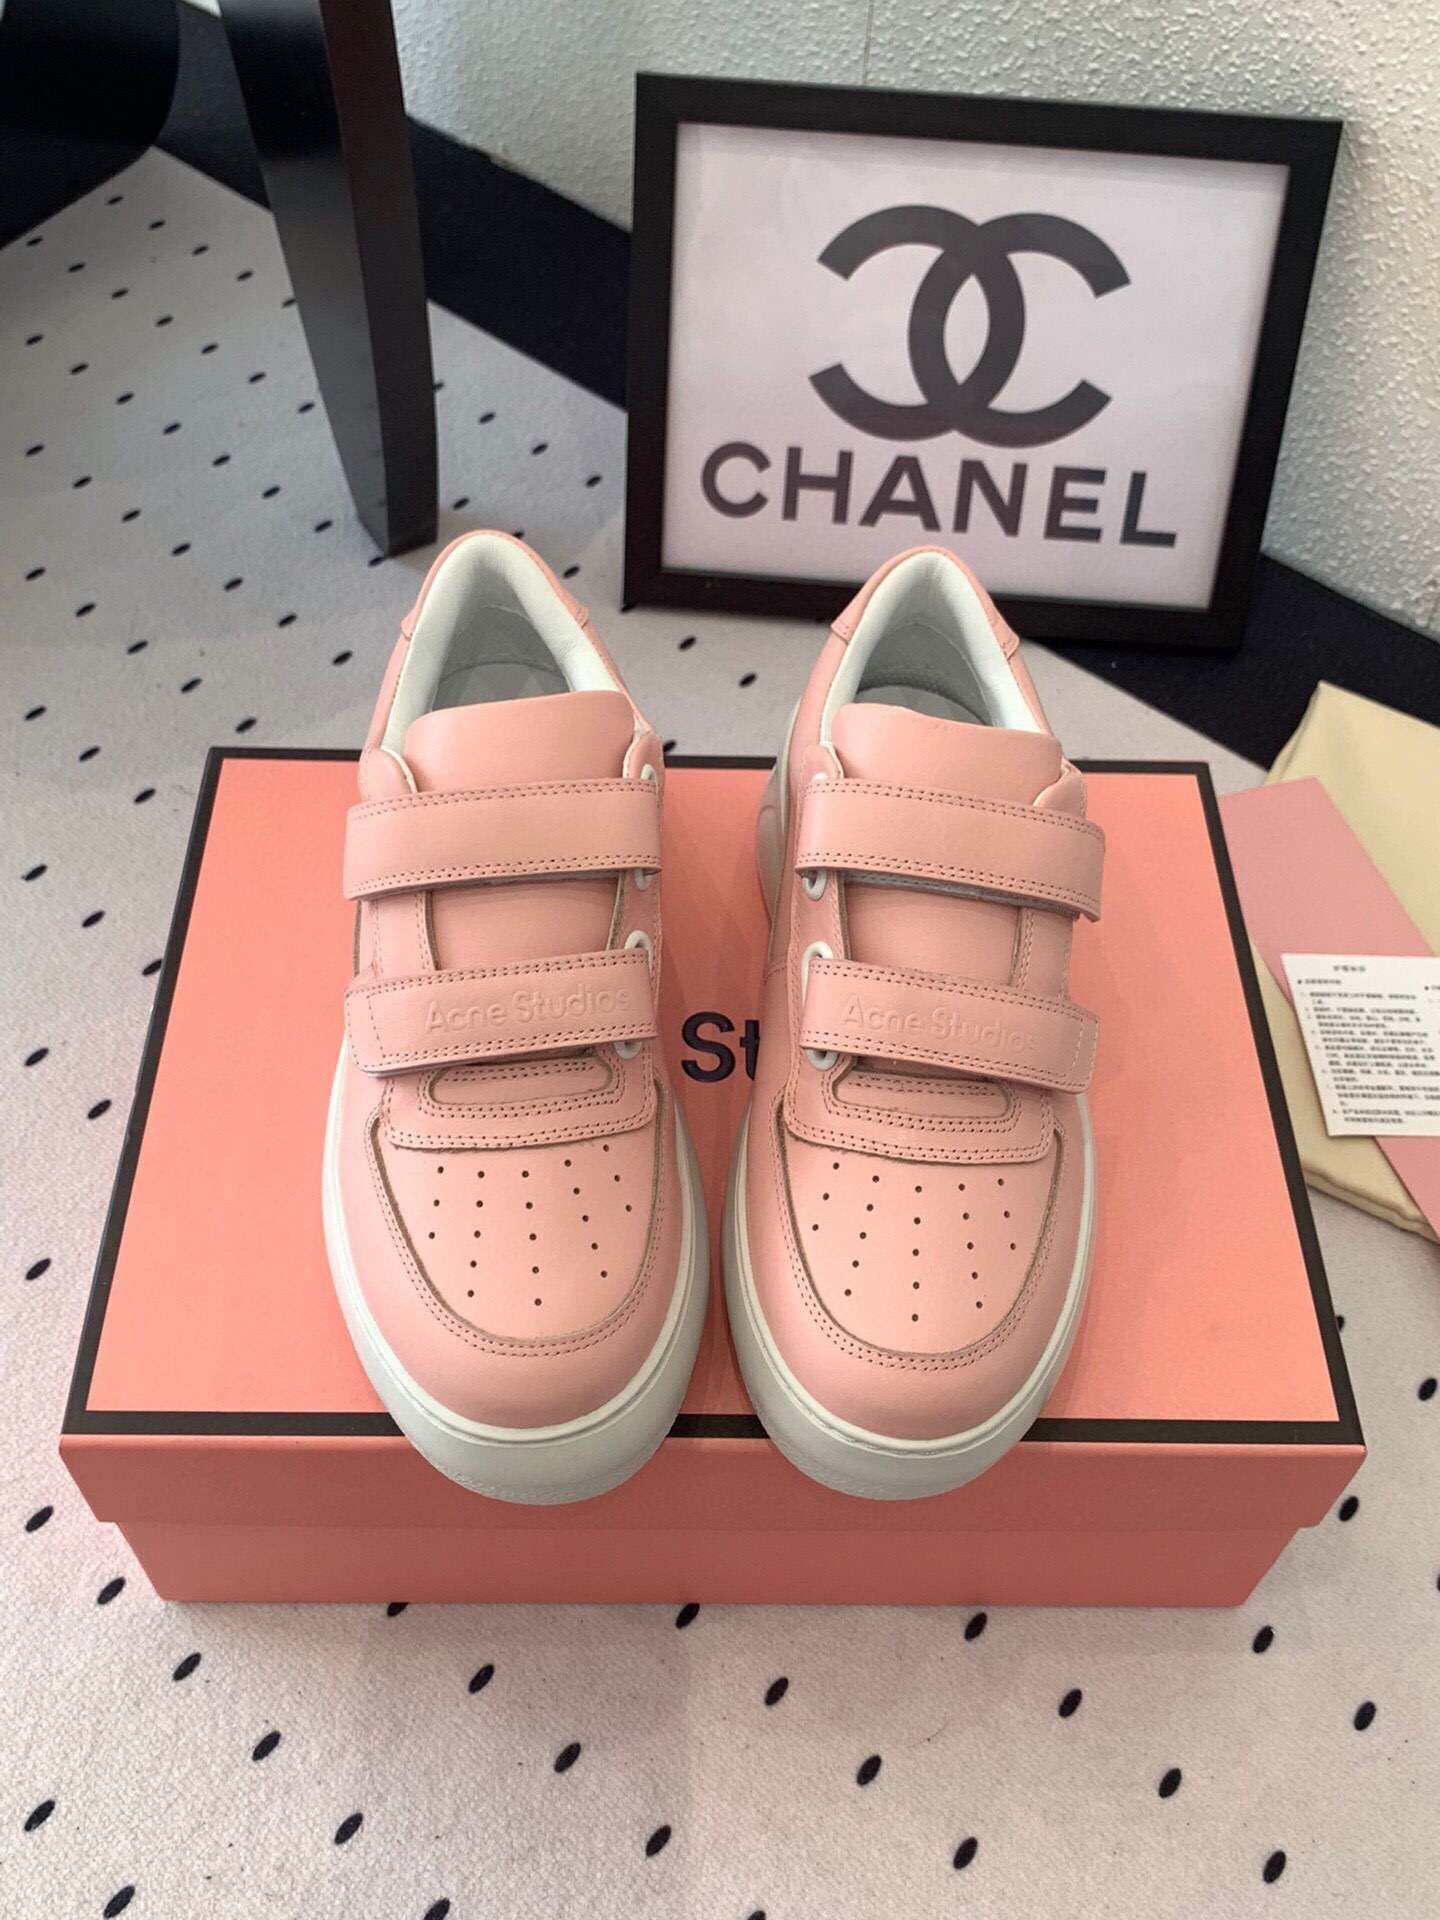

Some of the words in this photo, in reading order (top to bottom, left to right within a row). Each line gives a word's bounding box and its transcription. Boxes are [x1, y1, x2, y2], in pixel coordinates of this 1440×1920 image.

[701, 441, 1177, 549] CHANEL
[425, 1000, 507, 1035] Acne
[512, 984, 631, 1023] Studios
[841, 993, 923, 1032] Acne
[929, 1006, 1036, 1056] Studios
